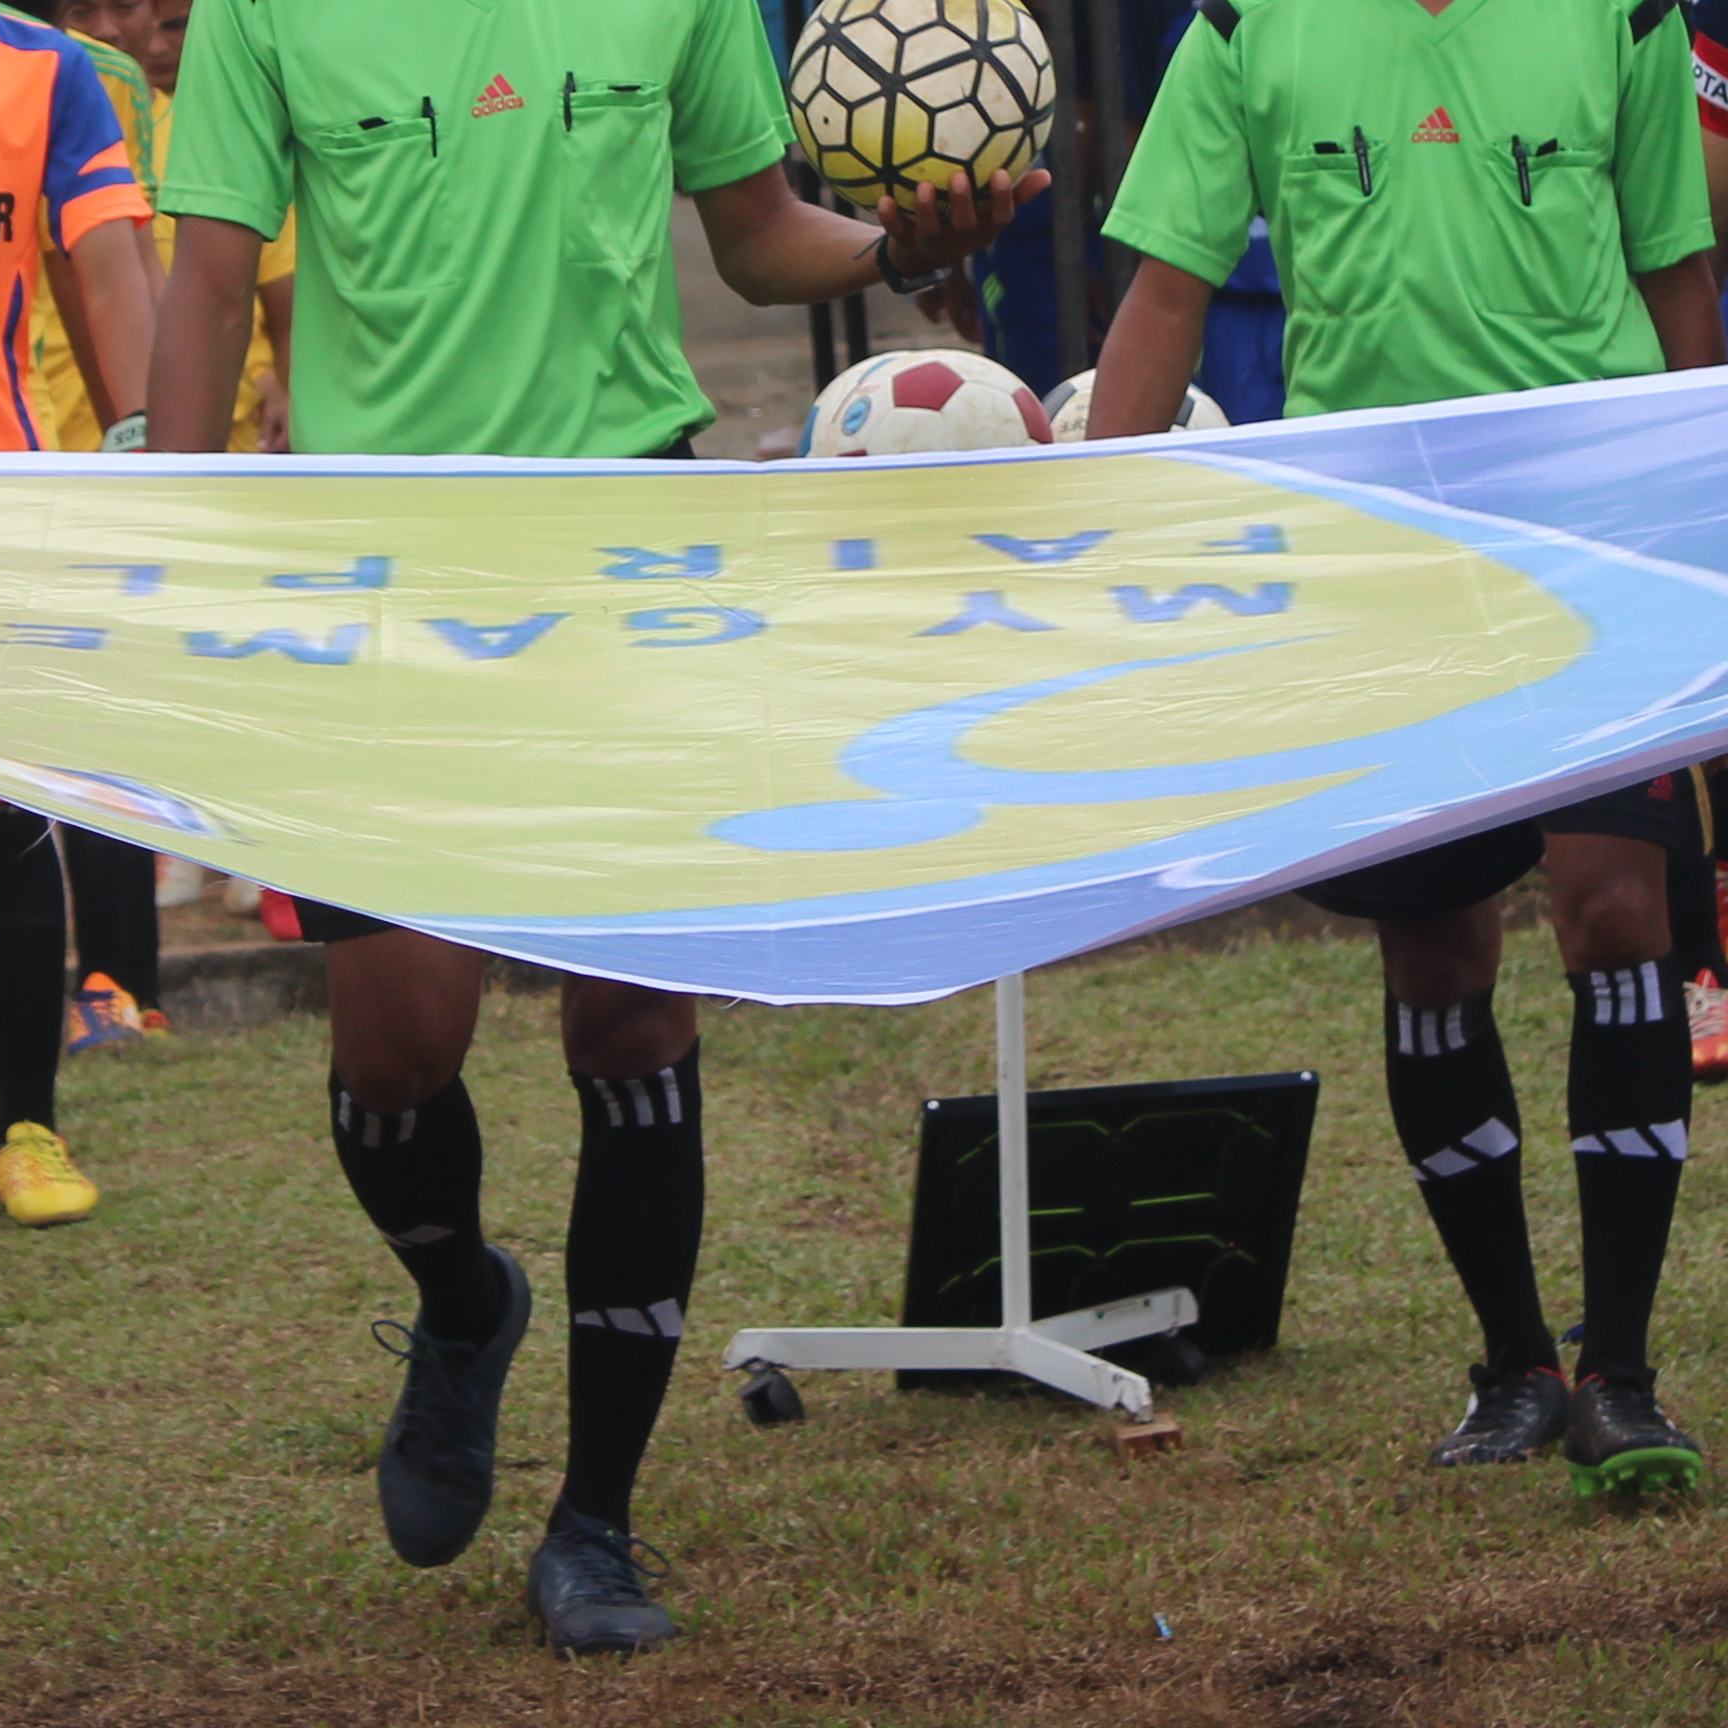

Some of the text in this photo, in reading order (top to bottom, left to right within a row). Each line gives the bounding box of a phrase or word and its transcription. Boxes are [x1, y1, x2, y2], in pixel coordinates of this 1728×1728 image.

[471, 97, 524, 119] adidas
[1411, 131, 1460, 144] adidas
[595, 524, 1288, 580] FAIR
[912, 582, 1296, 638] MY
